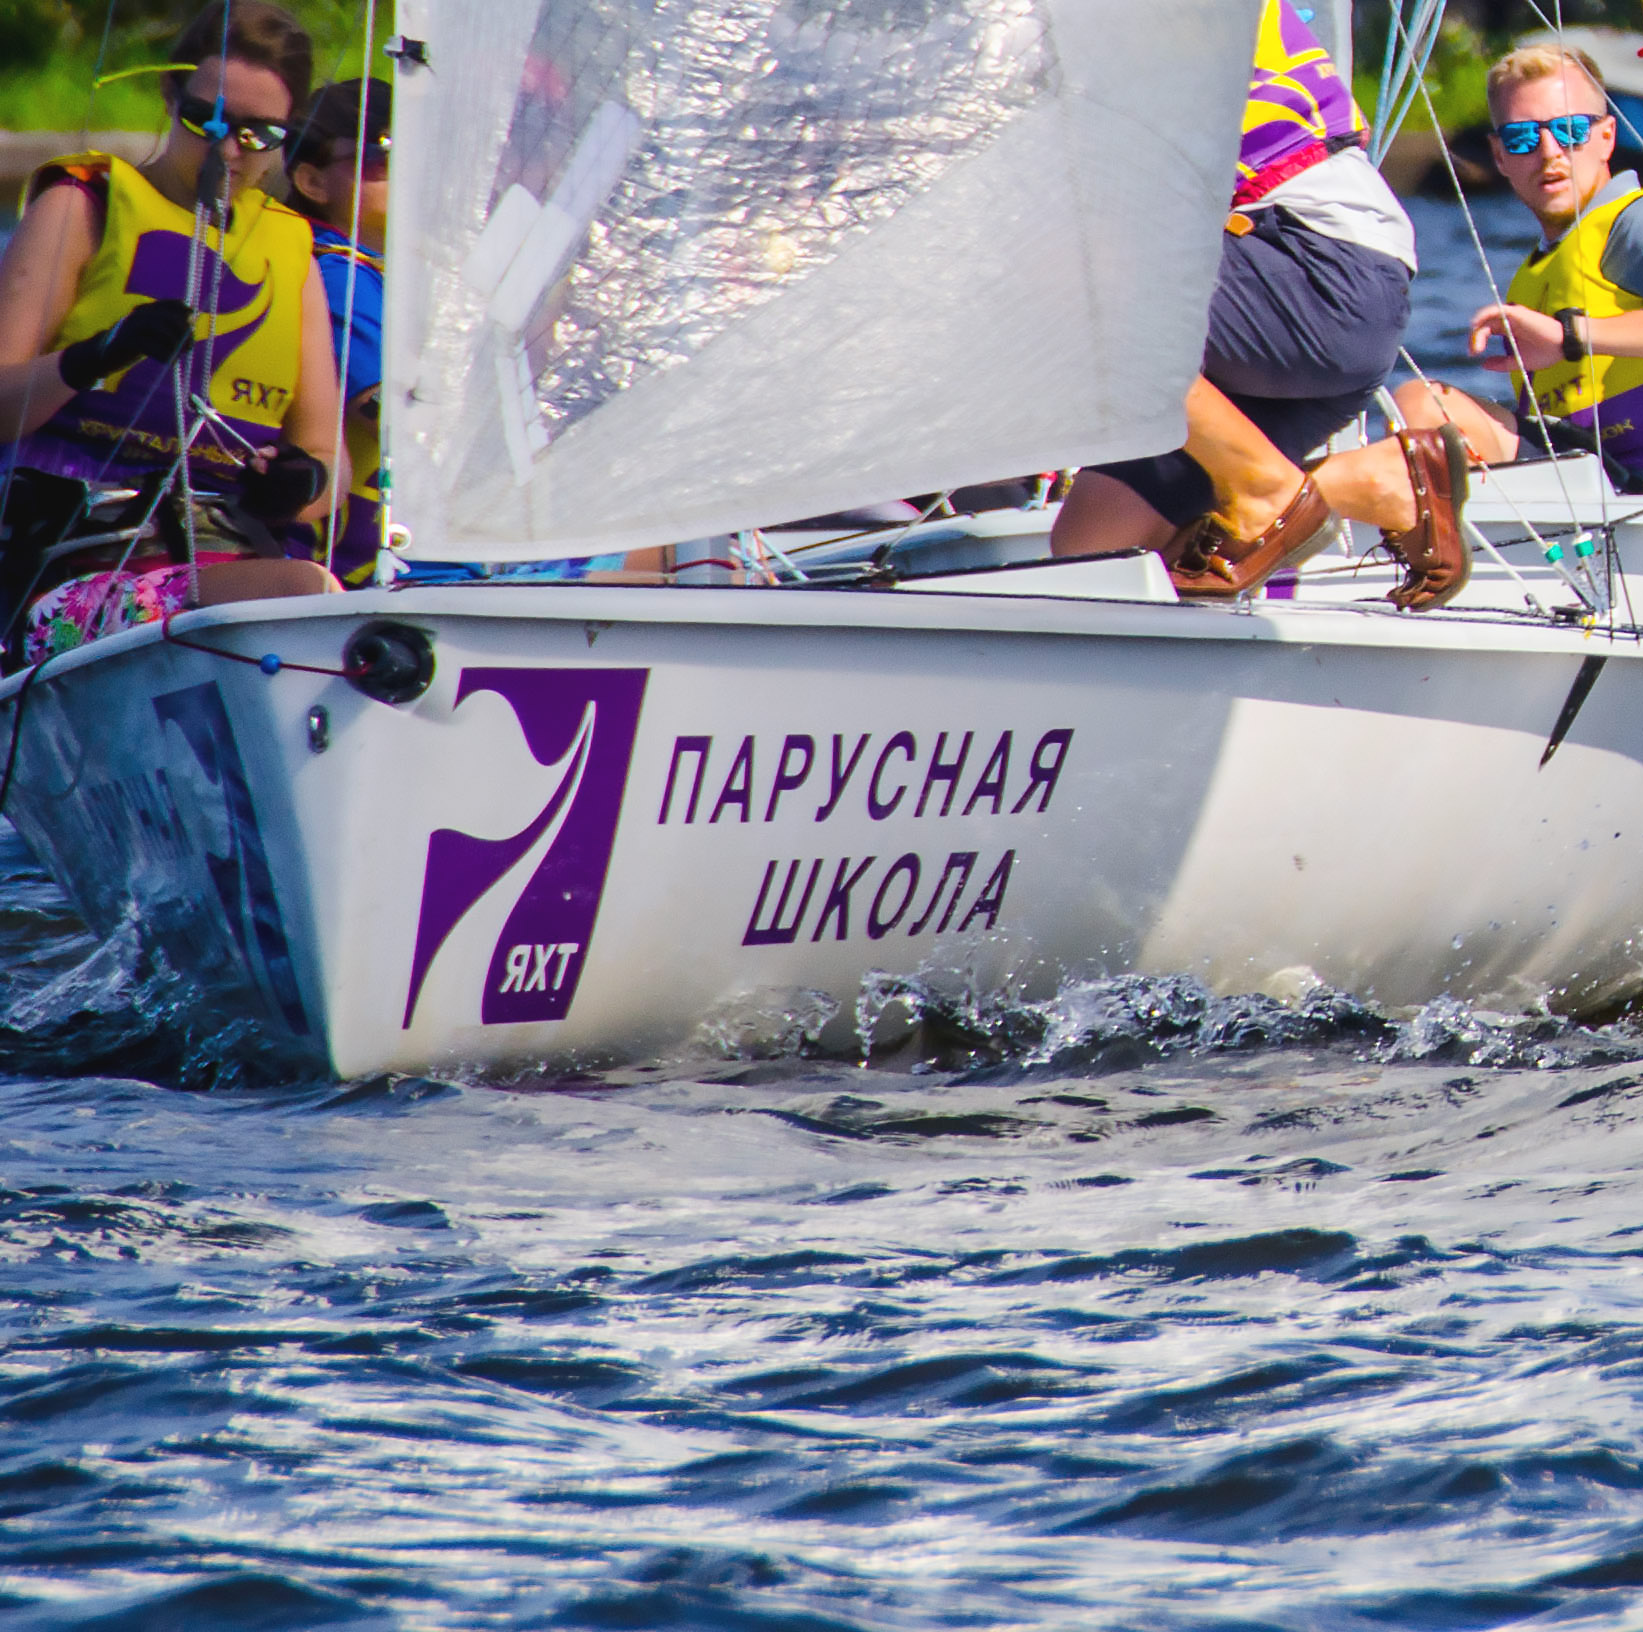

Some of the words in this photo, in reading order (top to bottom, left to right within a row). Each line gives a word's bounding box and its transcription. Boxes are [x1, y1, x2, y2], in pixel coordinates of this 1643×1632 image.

[657, 728, 1075, 825] ПАРУСНАЯ
[740, 849, 1016, 946] ШКОЛА
[499, 943, 579, 993] ЯХТ
